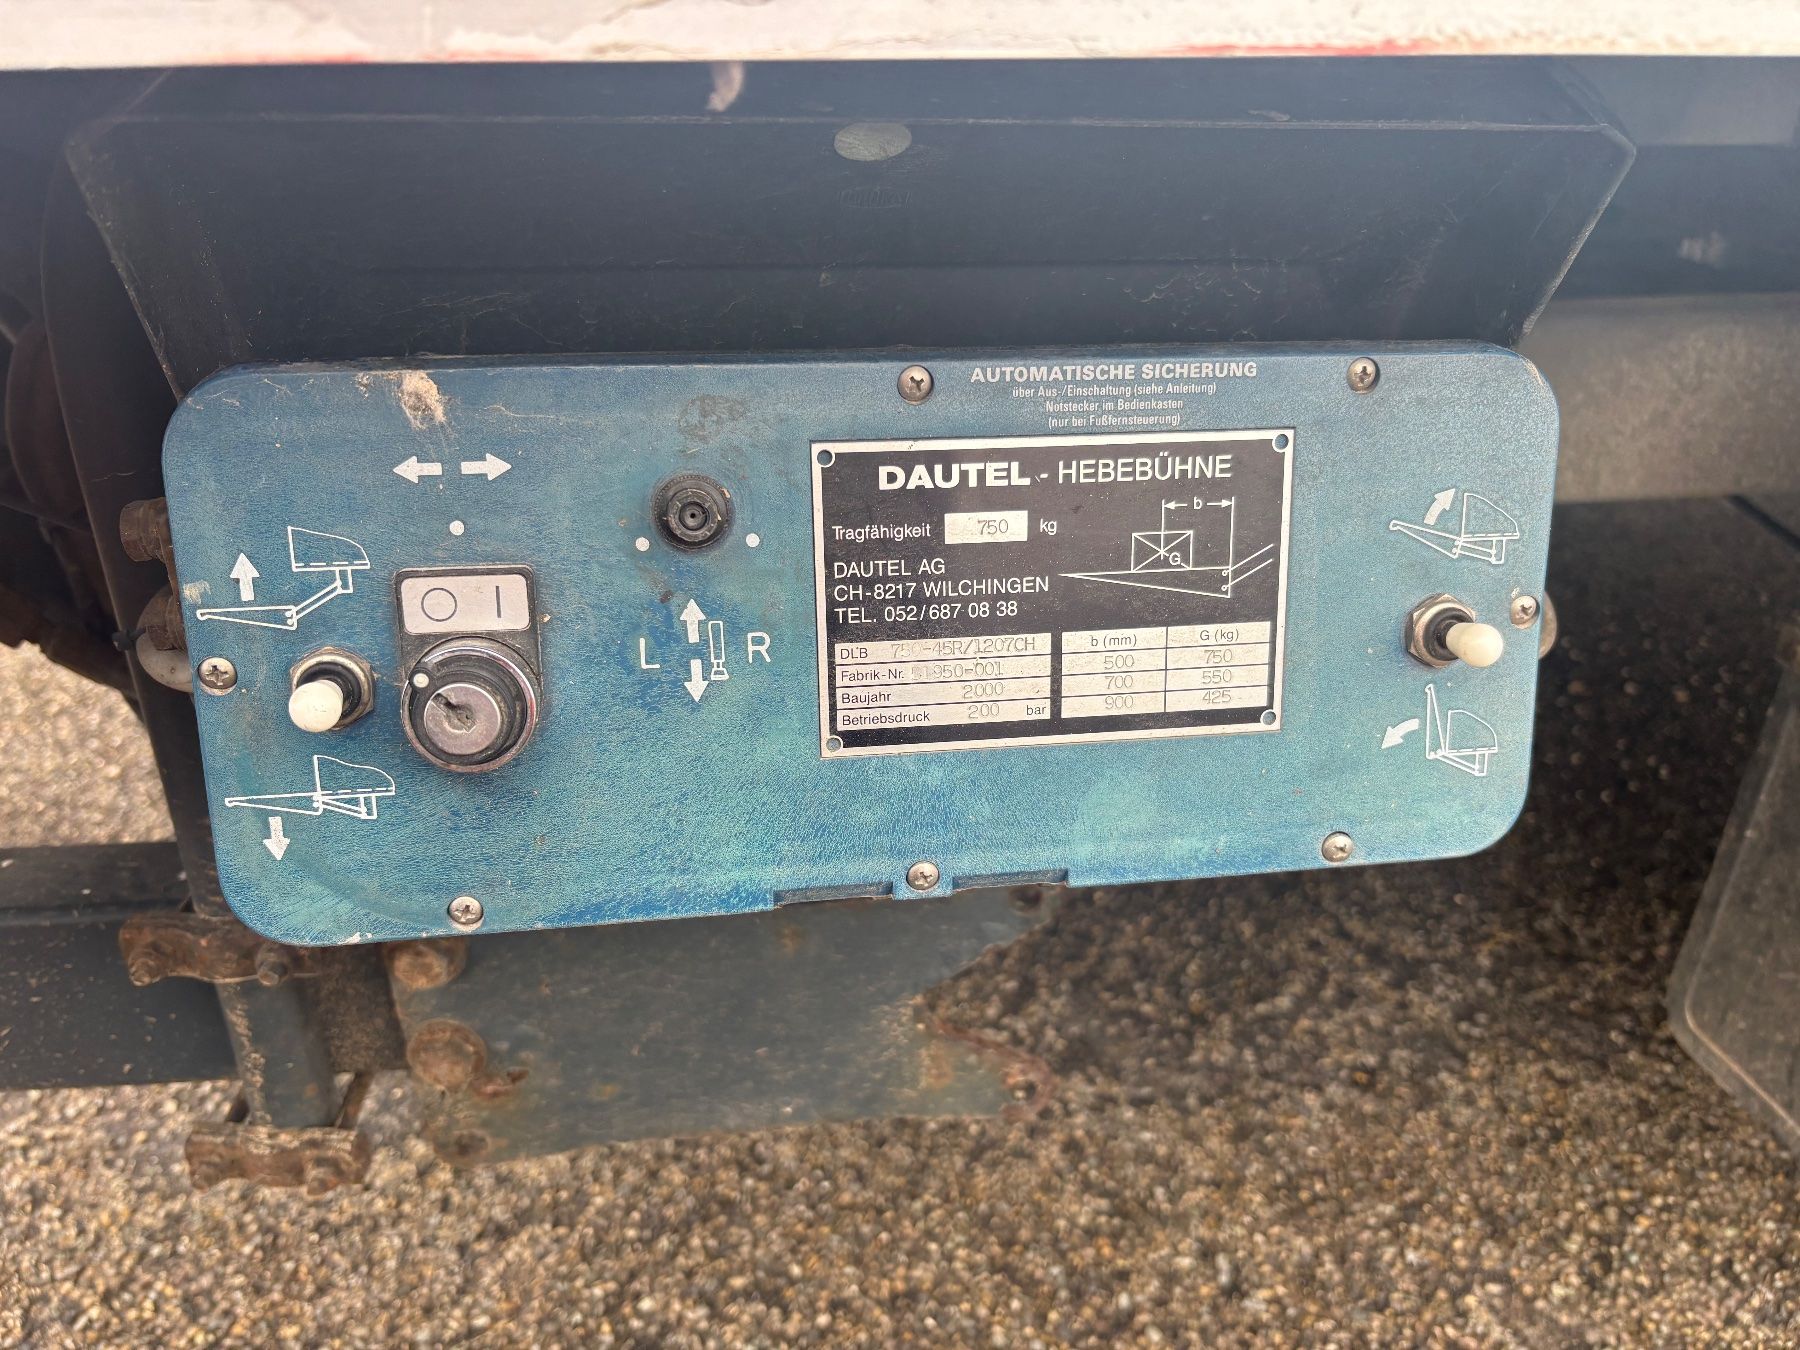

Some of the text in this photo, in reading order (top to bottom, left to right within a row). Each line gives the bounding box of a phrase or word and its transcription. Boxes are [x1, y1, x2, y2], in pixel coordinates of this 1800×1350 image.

[970, 361, 1257, 383] AUTOMATISCHE SICHERUNG
[1012, 381, 1217, 398] über Aus-/Einschaltung (siehe Anleitung)
[1045, 398, 1183, 413] Notstecker im Bedienkasten
[1048, 412, 1181, 430] (nur bei Fußfernsteuerung)
[878, 461, 1031, 490] DAUTEL
[1058, 451, 1233, 484] HEBEBÜHNE
[1193, 496, 1203, 510] b
[832, 518, 1057, 543] Tragfähigkeit 750 kg
[1168, 552, 1181, 565] G
[833, 558, 945, 579] DAUTEL AG
[833, 576, 1050, 602] CH-8217 WILCHINGEN
[833, 600, 1018, 624] TEL. 052/687 08 38
[1090, 633, 1137, 648] b (mm)
[1199, 627, 1239, 642] G (kg)
[639, 637, 661, 669] L
[747, 632, 772, 664] R
[840, 647, 868, 660] DLB
[1203, 648, 1233, 664] 750
[1103, 654, 1135, 671] 500
[841, 668, 904, 682] Fabrik-Nr.
[1104, 674, 1134, 690] 700
[1202, 668, 1233, 685] 550
[841, 681, 1005, 706] Baujahr 2000
[1202, 689, 1232, 705] 425
[1104, 695, 1134, 710] 900
[842, 702, 1047, 726] Betriebsdruck 200 bar
